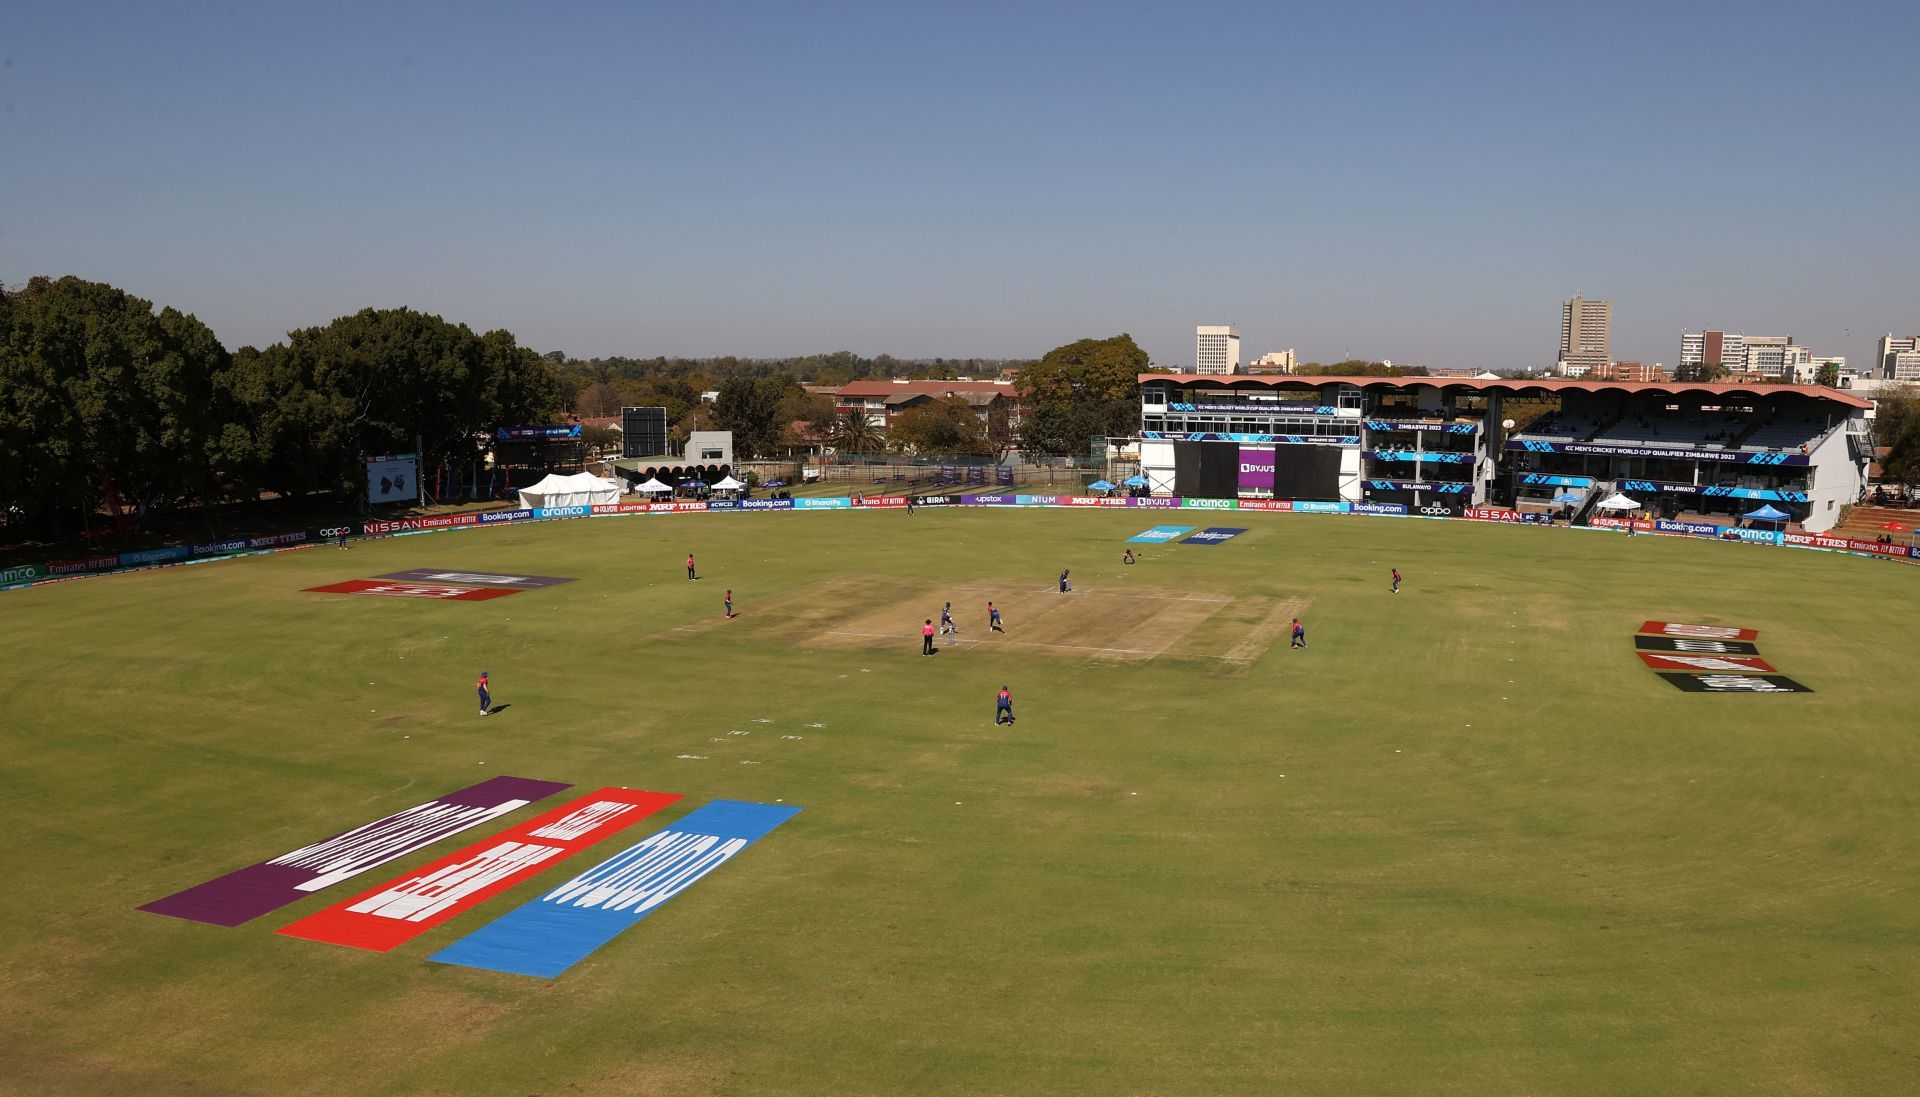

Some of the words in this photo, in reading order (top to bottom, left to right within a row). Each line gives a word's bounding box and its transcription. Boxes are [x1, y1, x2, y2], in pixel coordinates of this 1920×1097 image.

[743, 500, 790, 509] Booking.com
[977, 495, 1002, 504] upstox
[1190, 498, 1230, 507] aramco
[542, 506, 583, 516] aramco
[649, 501, 677, 511] MRF
[679, 502, 707, 511] TYRES
[1354, 504, 1402, 514] Booking.com
[1421, 506, 1451, 515] oppo
[483, 511, 530, 522] Booking.com
[1464, 509, 1522, 520] NISSAN
[364, 519, 421, 534] NISSAN
[423, 518, 452, 527] Emirates
[1661, 522, 1714, 535] Booking.com
[250, 536, 279, 547] MRF
[279, 531, 306, 543] TYRES
[1784, 533, 1814, 544] MRF
[1816, 536, 1847, 548] TYRES
[193, 540, 246, 555] Booking.com
[1850, 541, 1879, 552] Emirates
[1889, 547, 1906, 555] BETTER
[49, 561, 86, 575] Emirates
[541, 830, 748, 914] aramco
[344, 840, 566, 922] MRF
